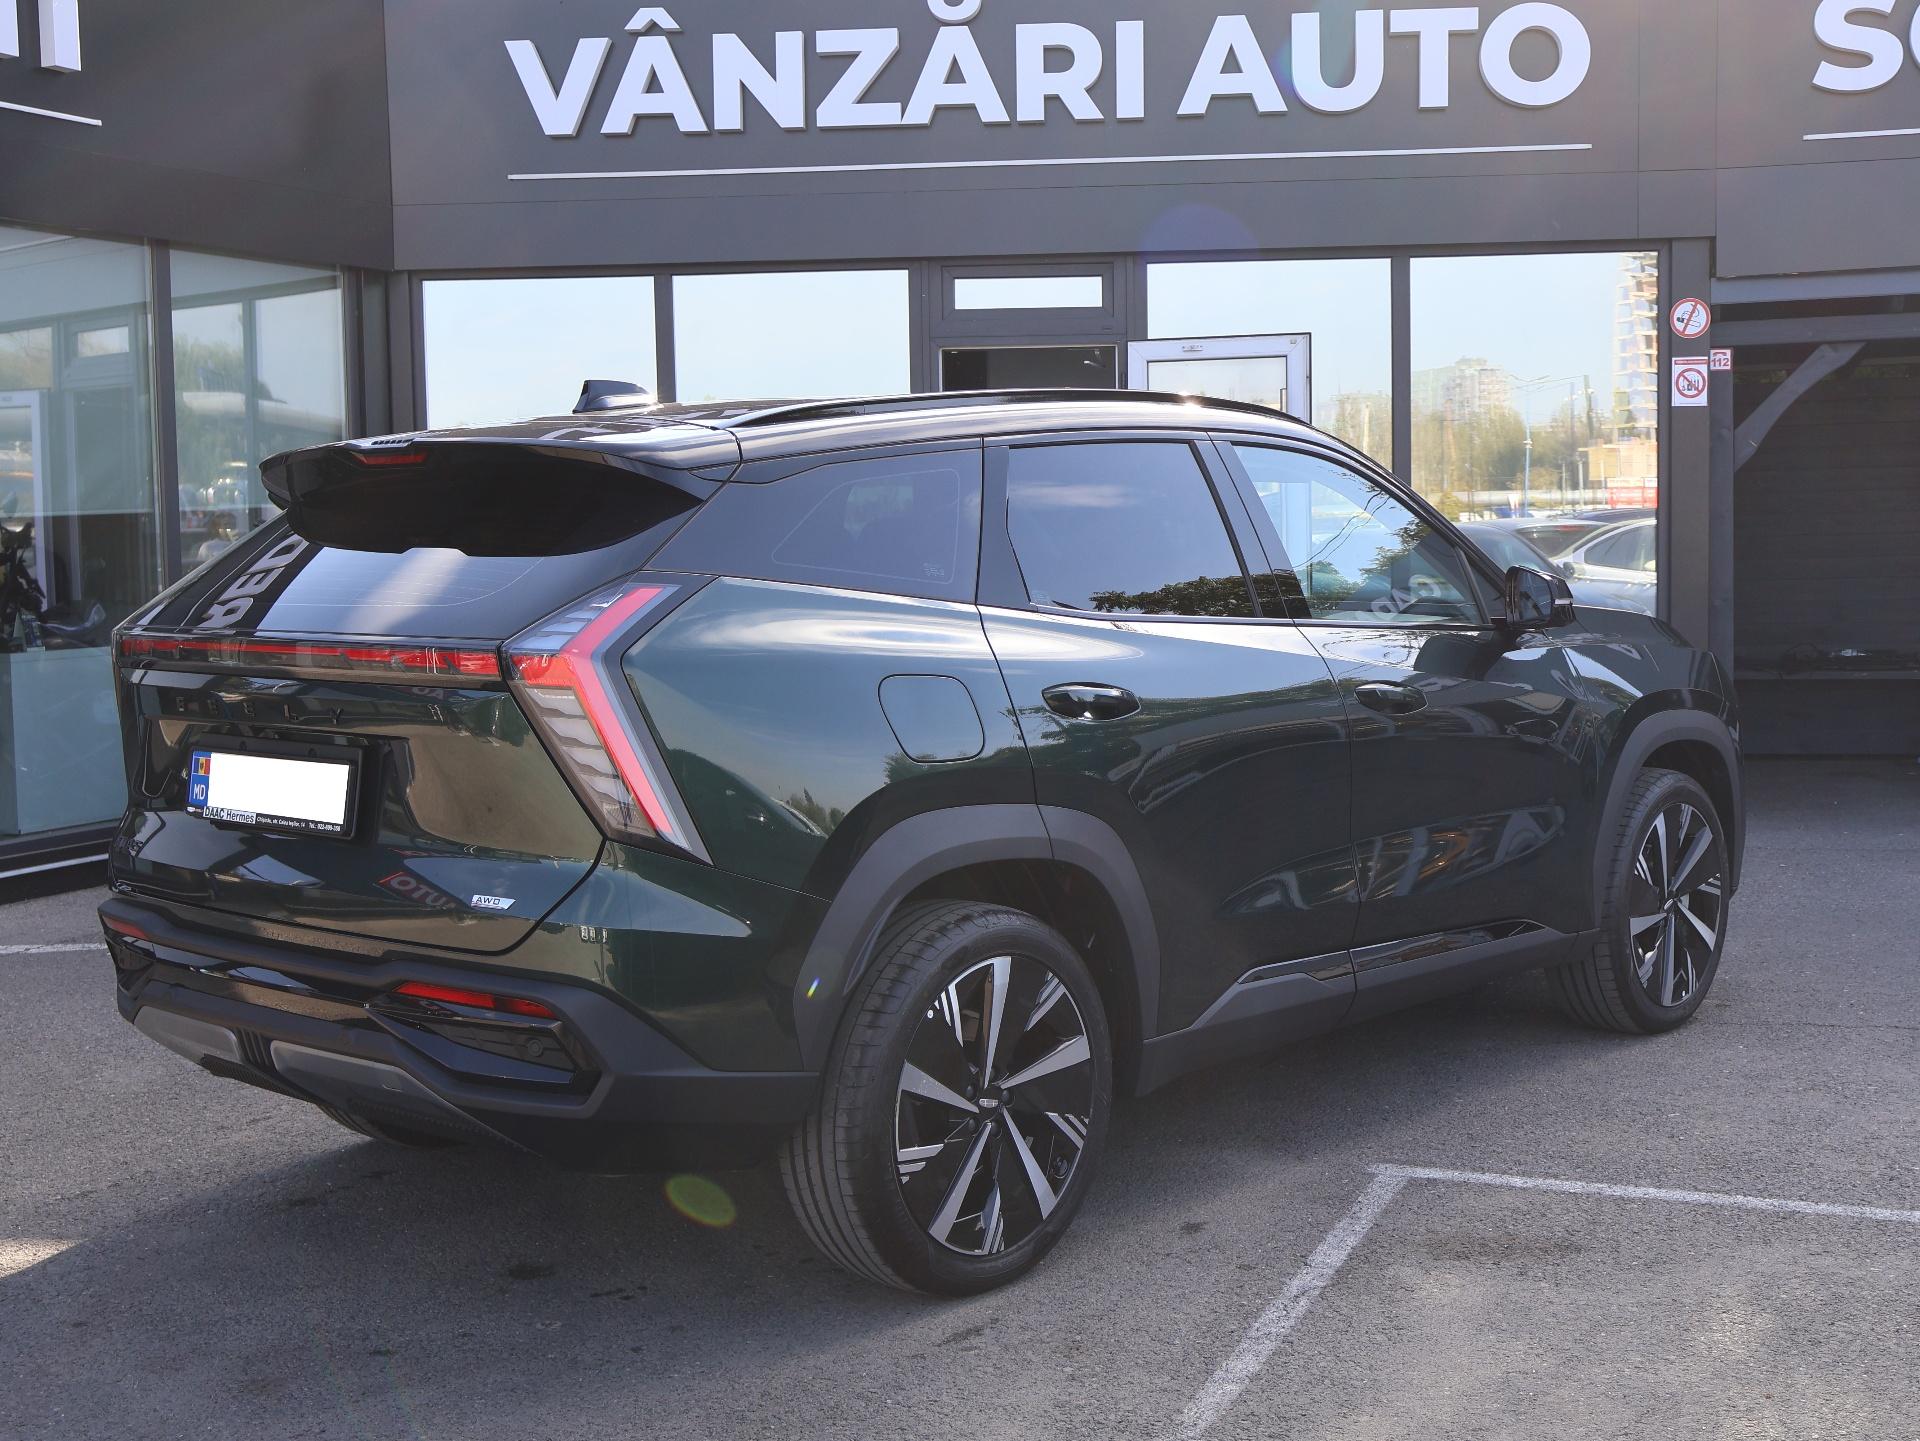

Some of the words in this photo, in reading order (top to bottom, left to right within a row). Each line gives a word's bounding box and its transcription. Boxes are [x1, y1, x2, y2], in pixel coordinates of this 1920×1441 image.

[1811, 0, 1920, 93] S
[504, 0, 1145, 137] VÂNZĂRI
[1177, 2, 1592, 117] AUTO
[1711, 357, 1730, 368] 112
[193, 783, 206, 800] MD
[204, 806, 225, 819] DAAC
[226, 810, 255, 824] Hermes
[476, 896, 500, 906] AWD
